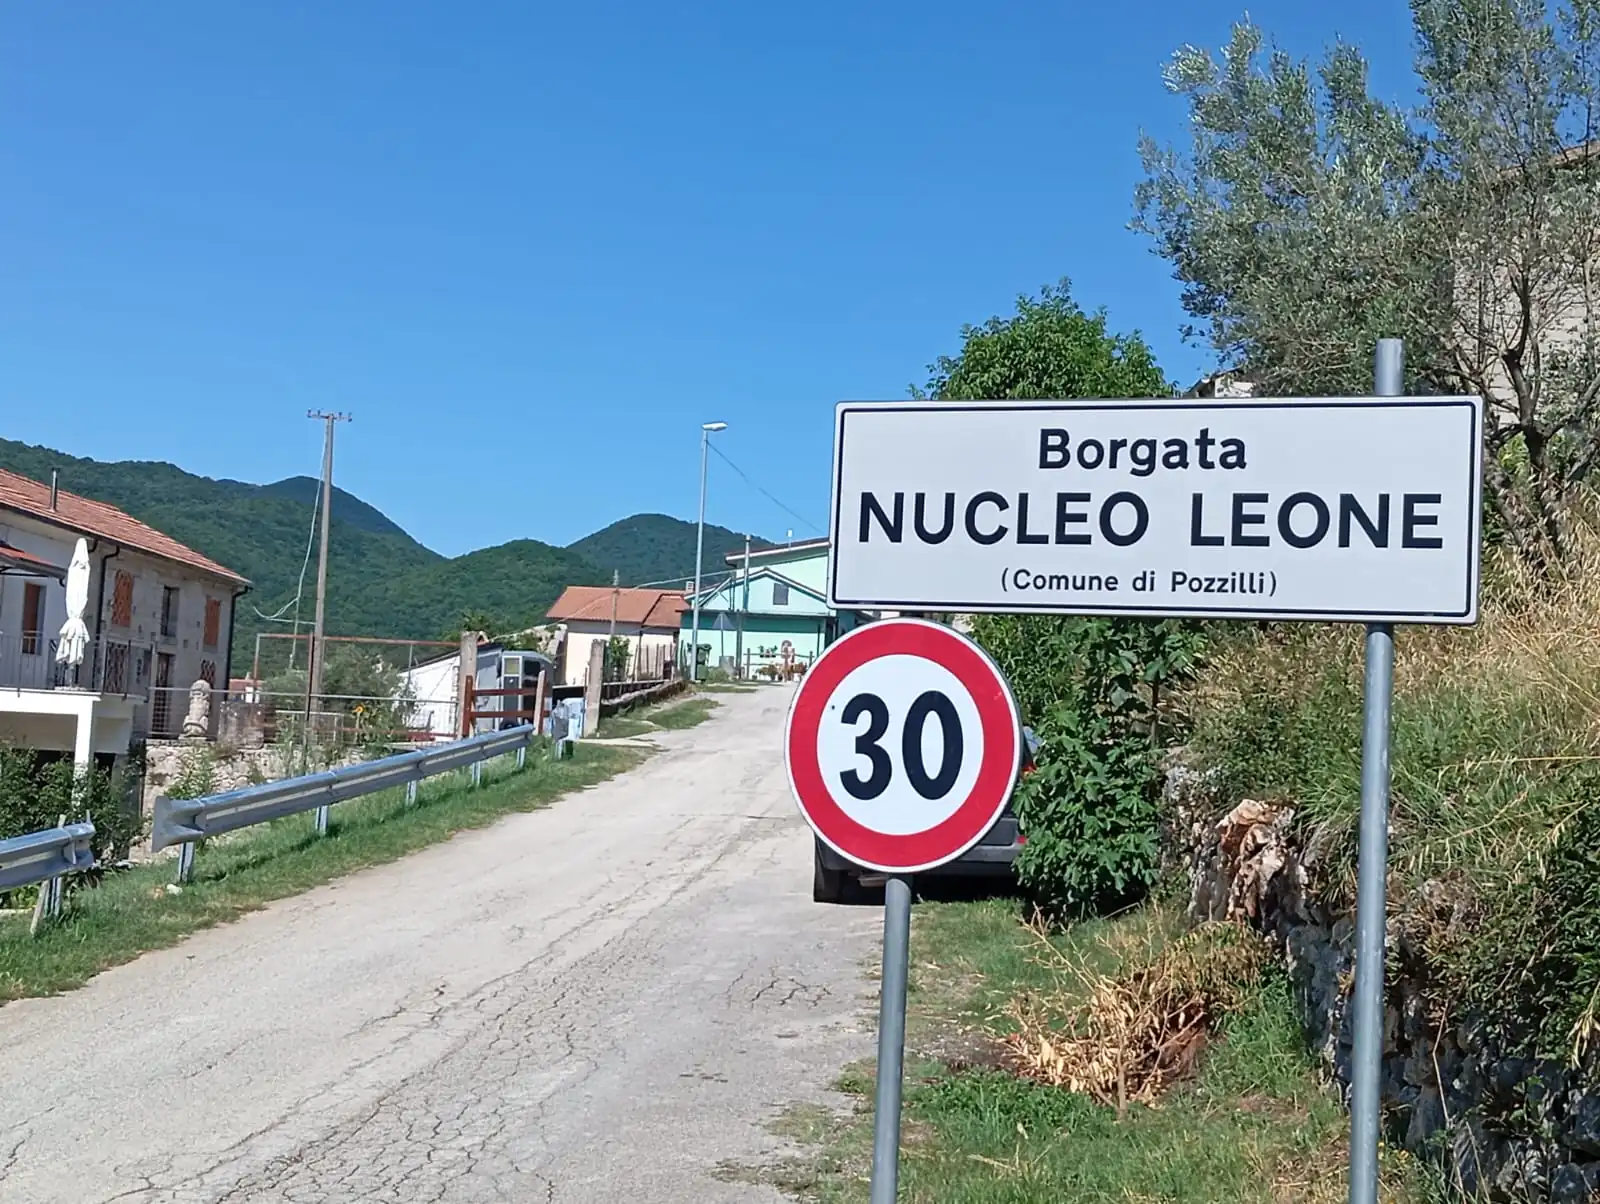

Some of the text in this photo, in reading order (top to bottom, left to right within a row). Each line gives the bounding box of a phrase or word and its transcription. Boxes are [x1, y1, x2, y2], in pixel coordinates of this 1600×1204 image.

[1038, 427, 1247, 477] Borgata
[858, 490, 1443, 549] NUCLEO LEONE
[1001, 567, 1277, 597] (Comune di Pozzilli)
[839, 690, 964, 801] 30
